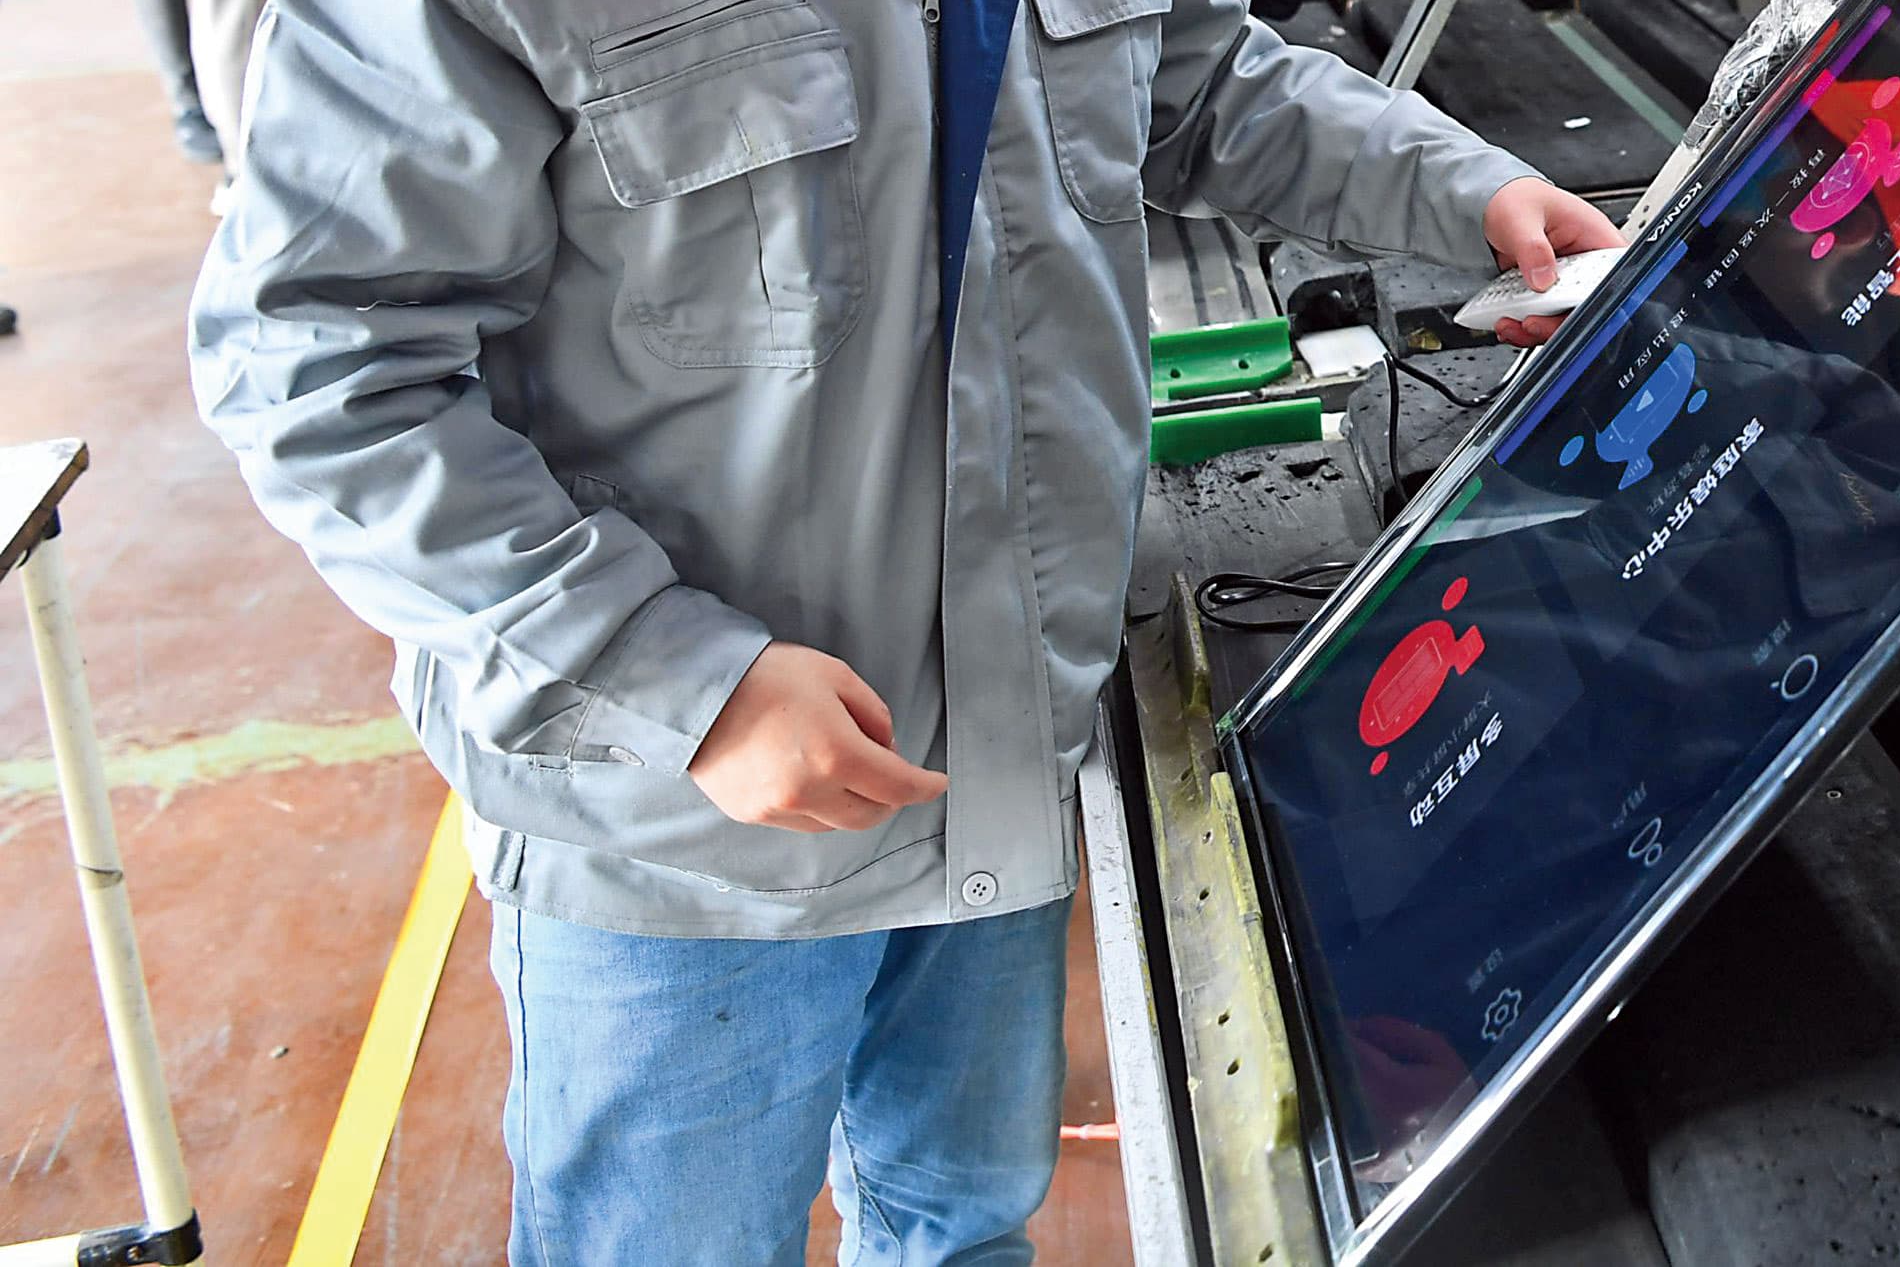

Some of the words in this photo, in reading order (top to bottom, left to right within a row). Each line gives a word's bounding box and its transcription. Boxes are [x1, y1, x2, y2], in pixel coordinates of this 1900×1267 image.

[1646, 182, 1703, 243] KONKA
[1622, 417, 1764, 580] 家庭娱乐中心
[1409, 712, 1503, 828] 多屏互动
